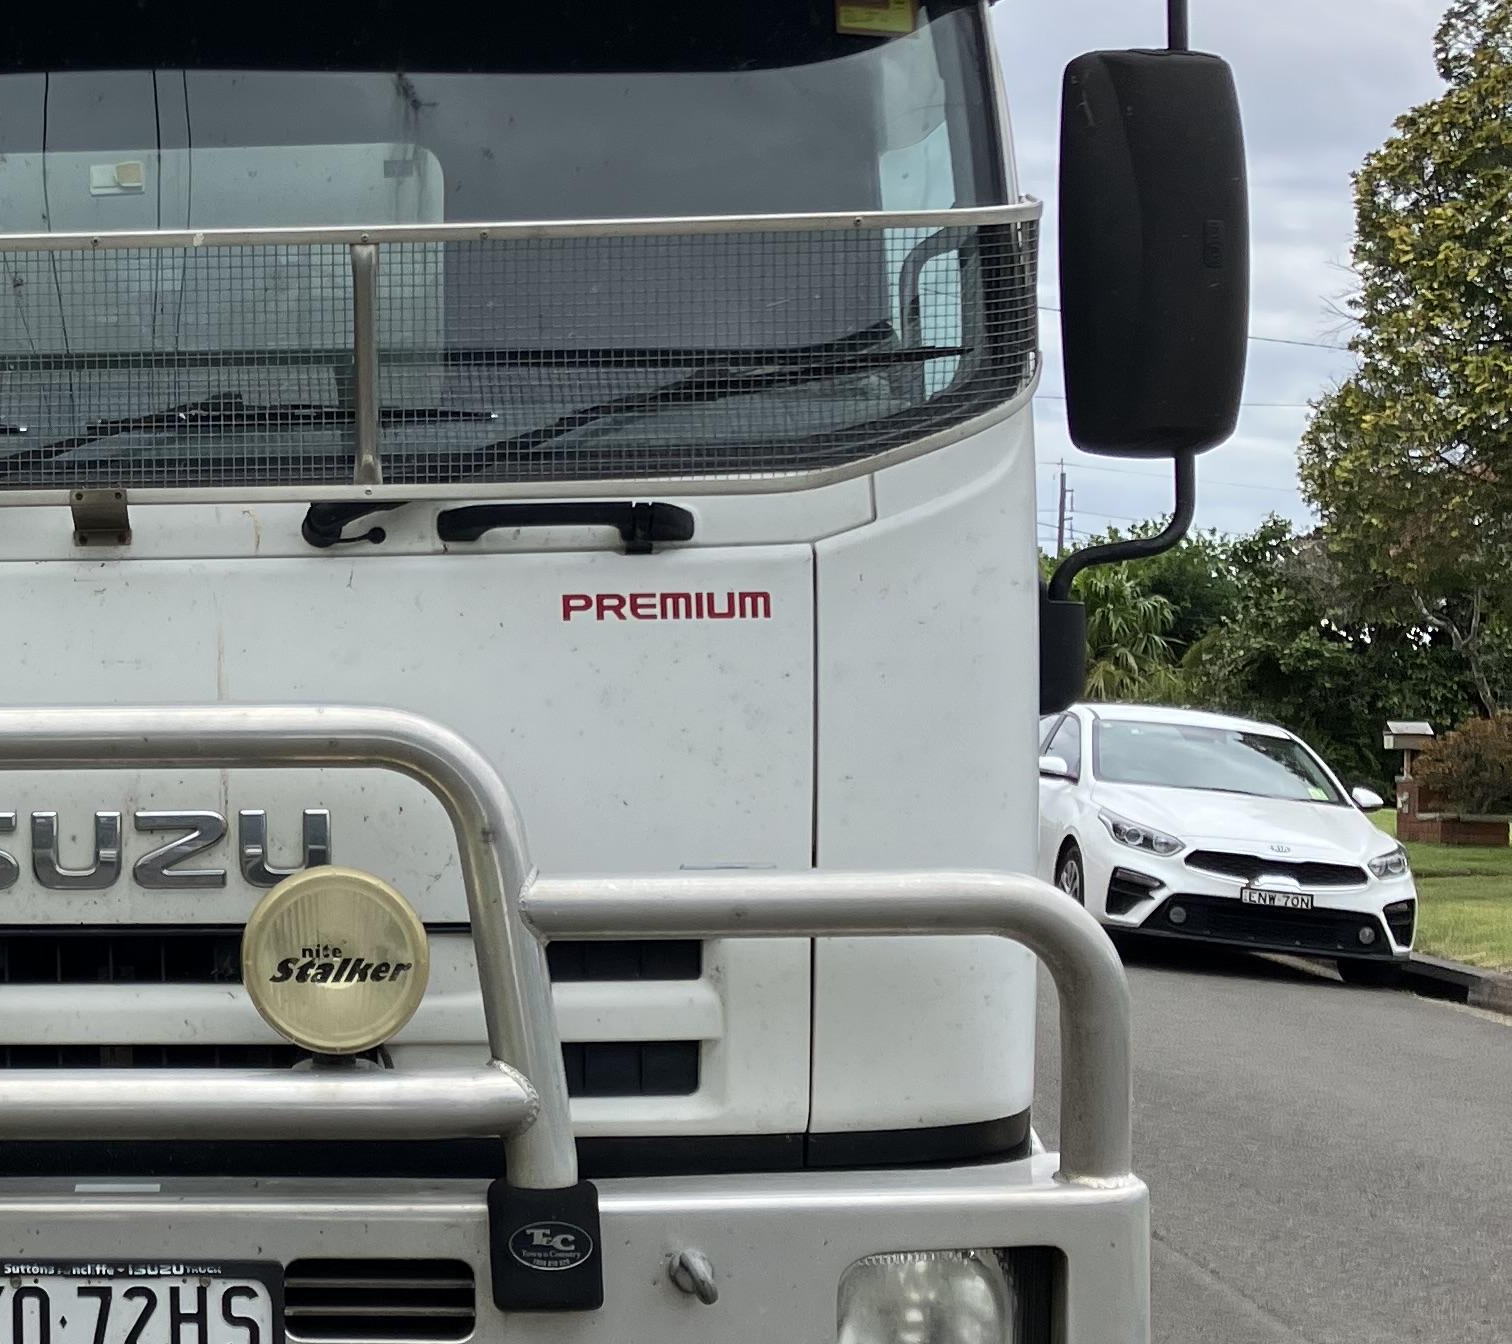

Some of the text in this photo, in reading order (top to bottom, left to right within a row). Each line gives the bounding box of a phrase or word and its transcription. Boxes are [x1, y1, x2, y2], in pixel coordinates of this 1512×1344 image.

[561, 591, 771, 621] PREMIUM
[300, 944, 343, 959] nite
[269, 957, 412, 984] Stalker
[3, 1263, 55, 1275] Suttons
